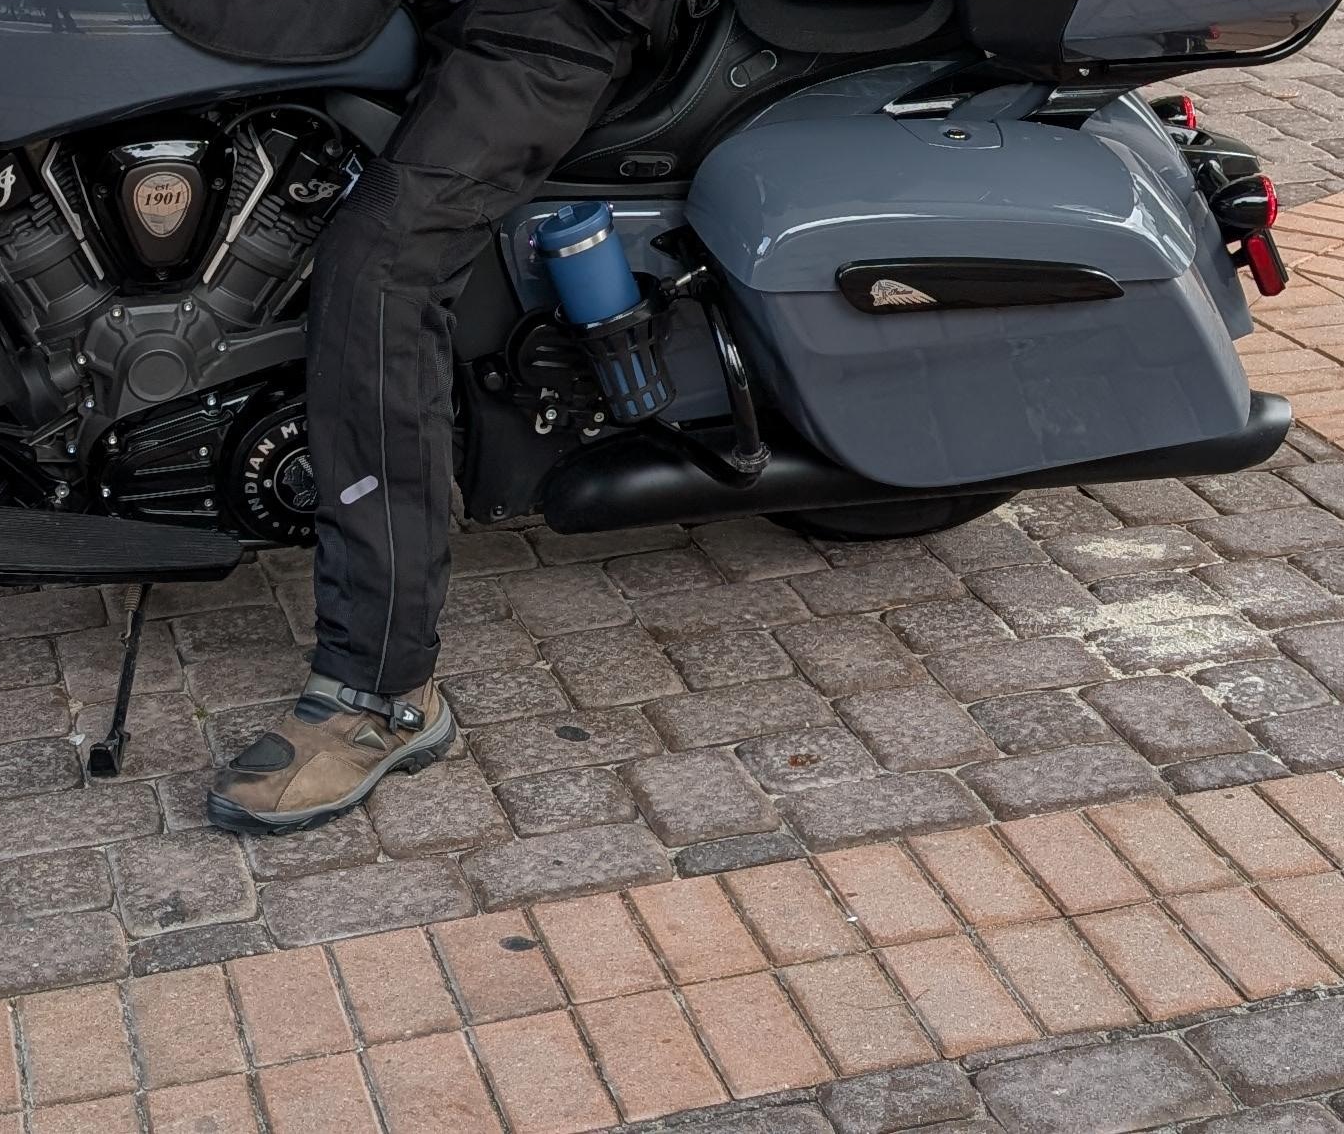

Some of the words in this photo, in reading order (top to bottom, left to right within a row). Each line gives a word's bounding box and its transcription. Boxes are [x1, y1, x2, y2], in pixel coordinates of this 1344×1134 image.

[155, 183, 171, 191] est.
[145, 191, 181, 206] 1901
[244, 438, 276, 520] INDIAN
